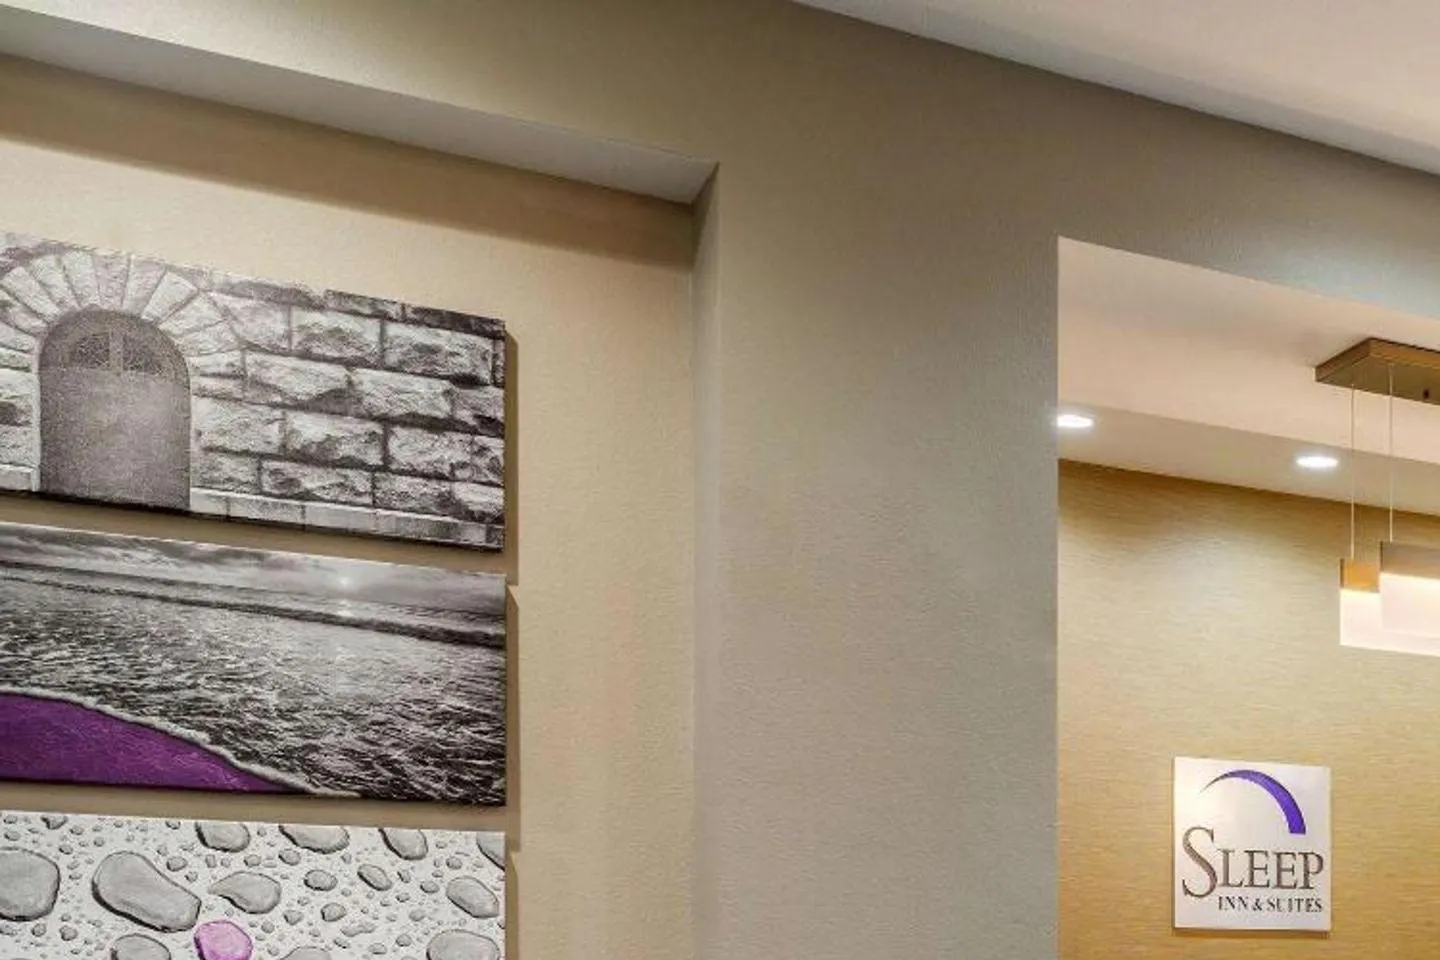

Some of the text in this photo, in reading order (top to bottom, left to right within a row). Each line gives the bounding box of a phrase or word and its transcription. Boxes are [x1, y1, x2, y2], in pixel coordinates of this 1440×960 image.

[1182, 826, 1324, 898] SLEEP
[1218, 896, 1323, 913] INN & SUITES
